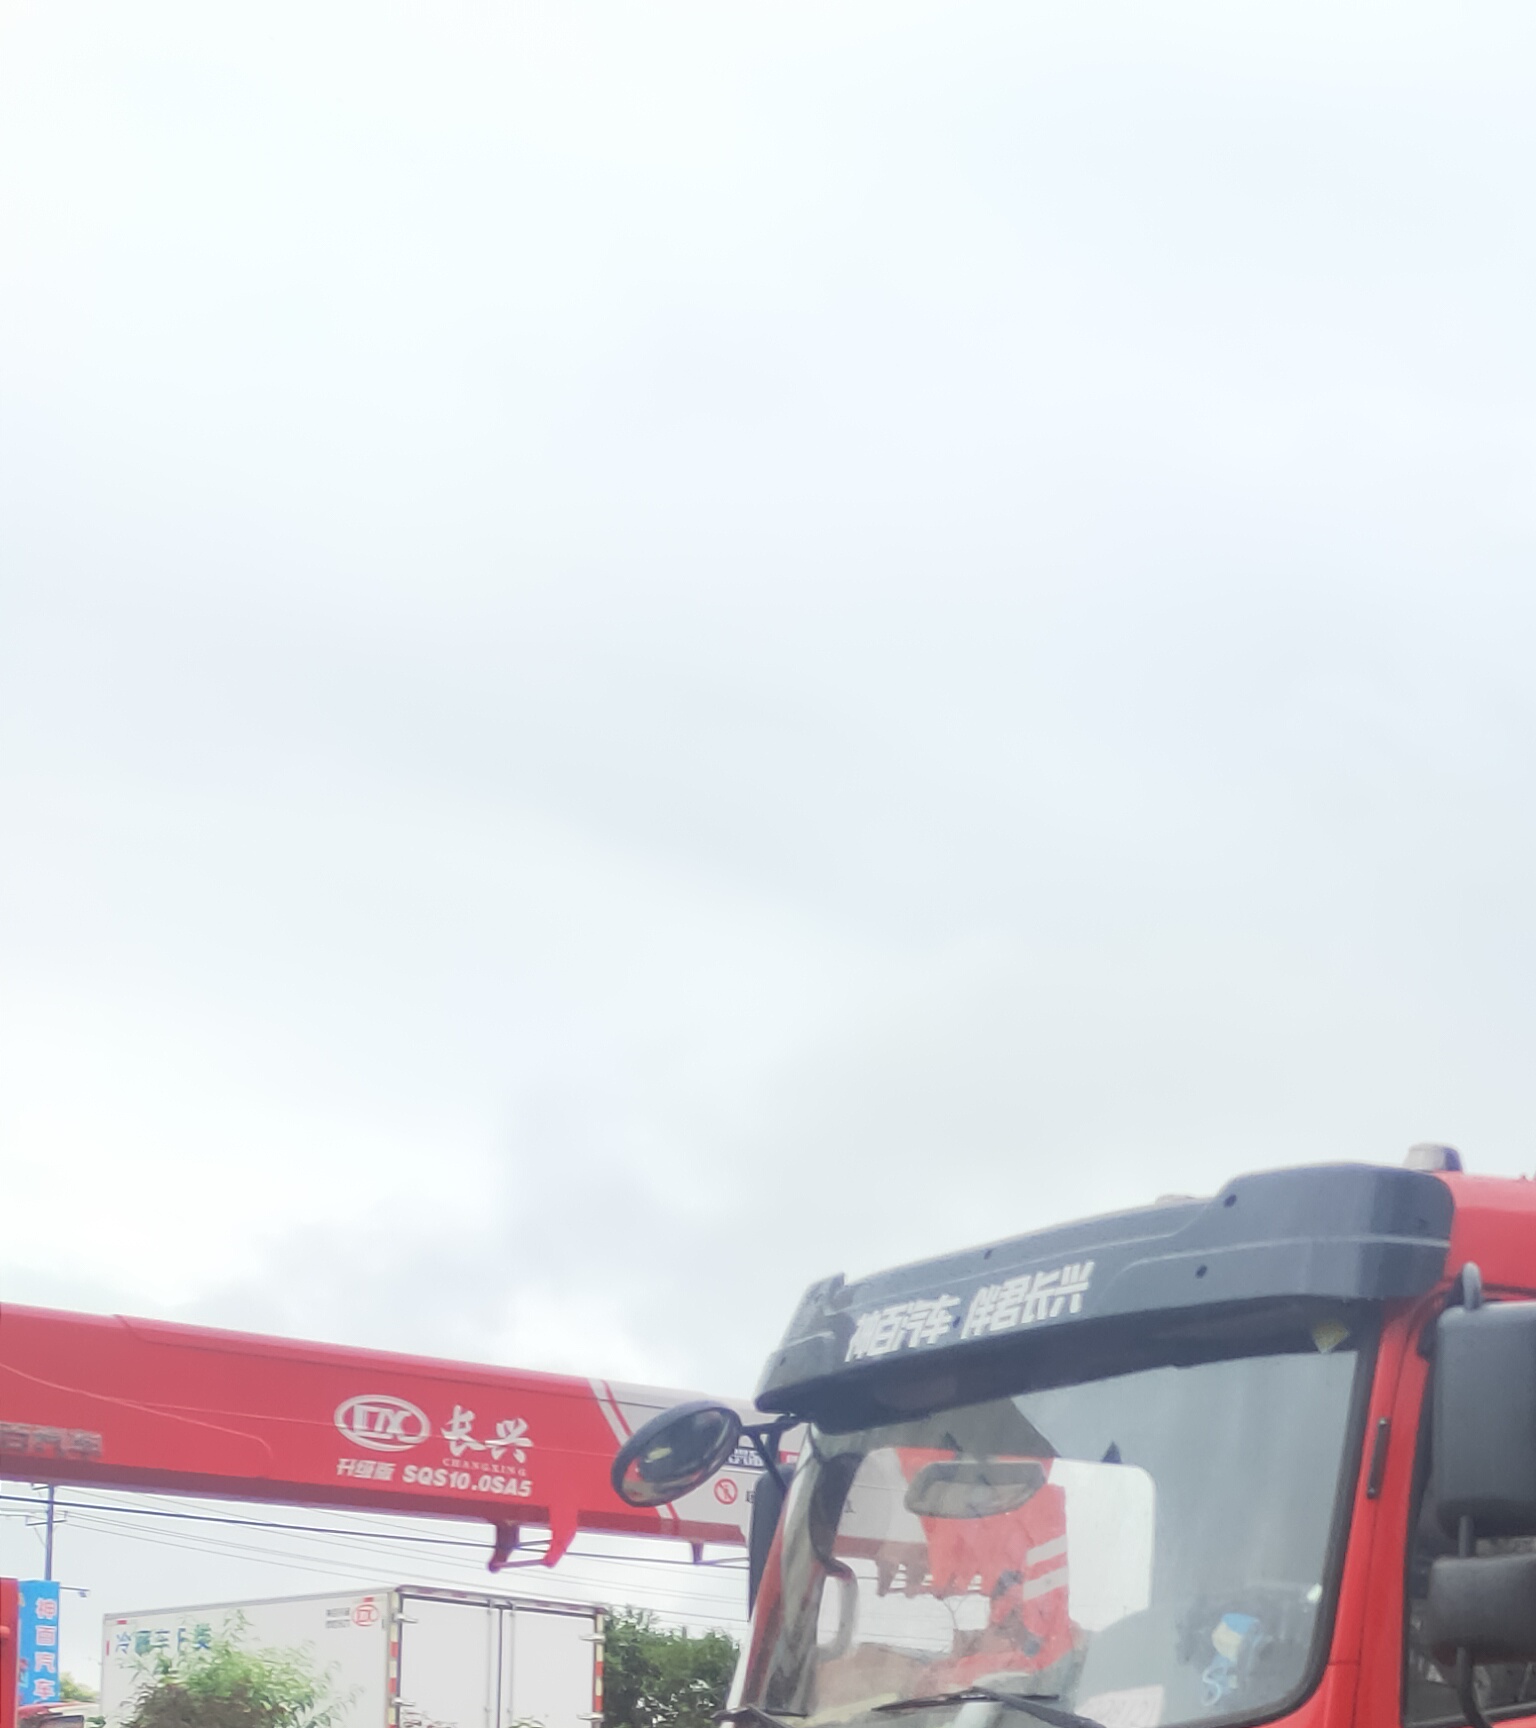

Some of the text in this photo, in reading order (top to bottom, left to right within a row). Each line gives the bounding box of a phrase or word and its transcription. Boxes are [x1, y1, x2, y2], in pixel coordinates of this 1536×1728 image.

[844, 1260, 1094, 1362] 神百汽车 伴君长兴
[440, 1404, 534, 1463] 长兴
[402, 1464, 532, 1497] SQS10.0SA5
